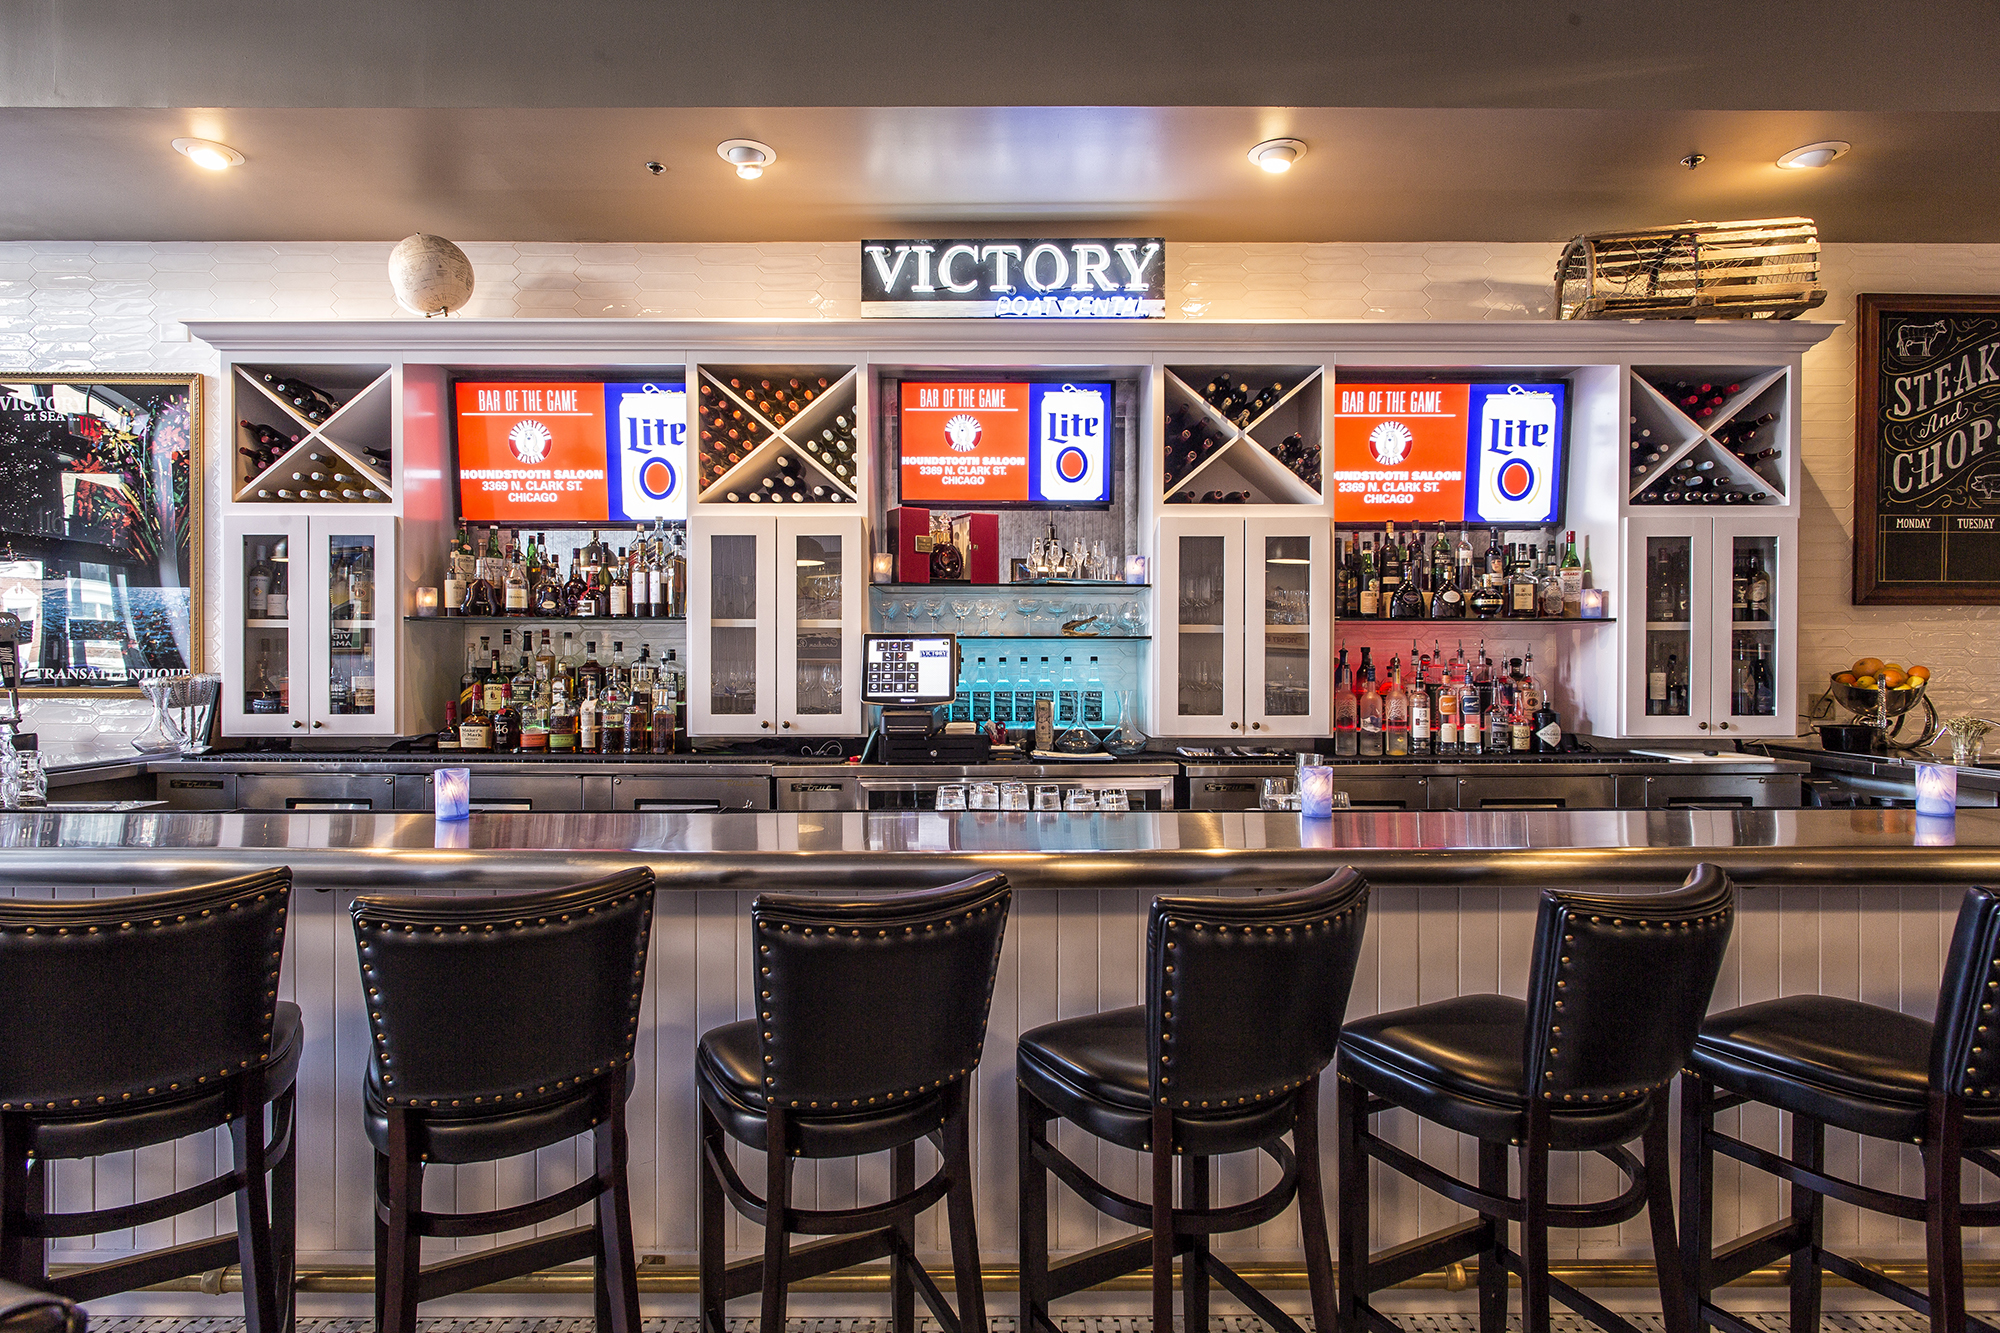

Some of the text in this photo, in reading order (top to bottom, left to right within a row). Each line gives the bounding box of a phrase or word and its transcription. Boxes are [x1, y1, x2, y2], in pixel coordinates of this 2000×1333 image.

[865, 243, 1160, 293] VICTORY
[995, 296, 1150, 317] BOAT RENTAL
[1893, 342, 2000, 417] STEAK
[478, 389, 578, 412] BAR OF THE GAME
[920, 388, 1006, 408] BAR OF THE GAME
[1341, 390, 1442, 413] BAR OF THE GAME
[23, 412, 36, 421] at
[39, 411, 66, 421] SEA
[1920, 401, 1969, 438] And
[1047, 412, 1098, 444] Lite
[626, 416, 687, 454] Lite
[1487, 418, 1549, 455] Lite
[902, 456, 1025, 466] HOUNDSTOOTH SALOON
[1893, 418, 2000, 493] CHOP
[460, 470, 604, 480] HOUNDSTOOTH SALOON
[919, 466, 1007, 475] 3369 N. CLARK ST.
[1333, 471, 1462, 481] UNDSTOOTH SALOON
[482, 481, 583, 491] 3369 N. CLARK ST.
[941, 476, 985, 485] CHICAGO
[1338, 482, 1440, 492] 3369 N. CLARK ST.
[508, 492, 558, 503] CHICAGO
[1363, 493, 1414, 504] CHICAGO
[1896, 518, 1995, 529] MONDAY TUESDAY
[36, 668, 190, 680] TRANSATLANTIQUE
